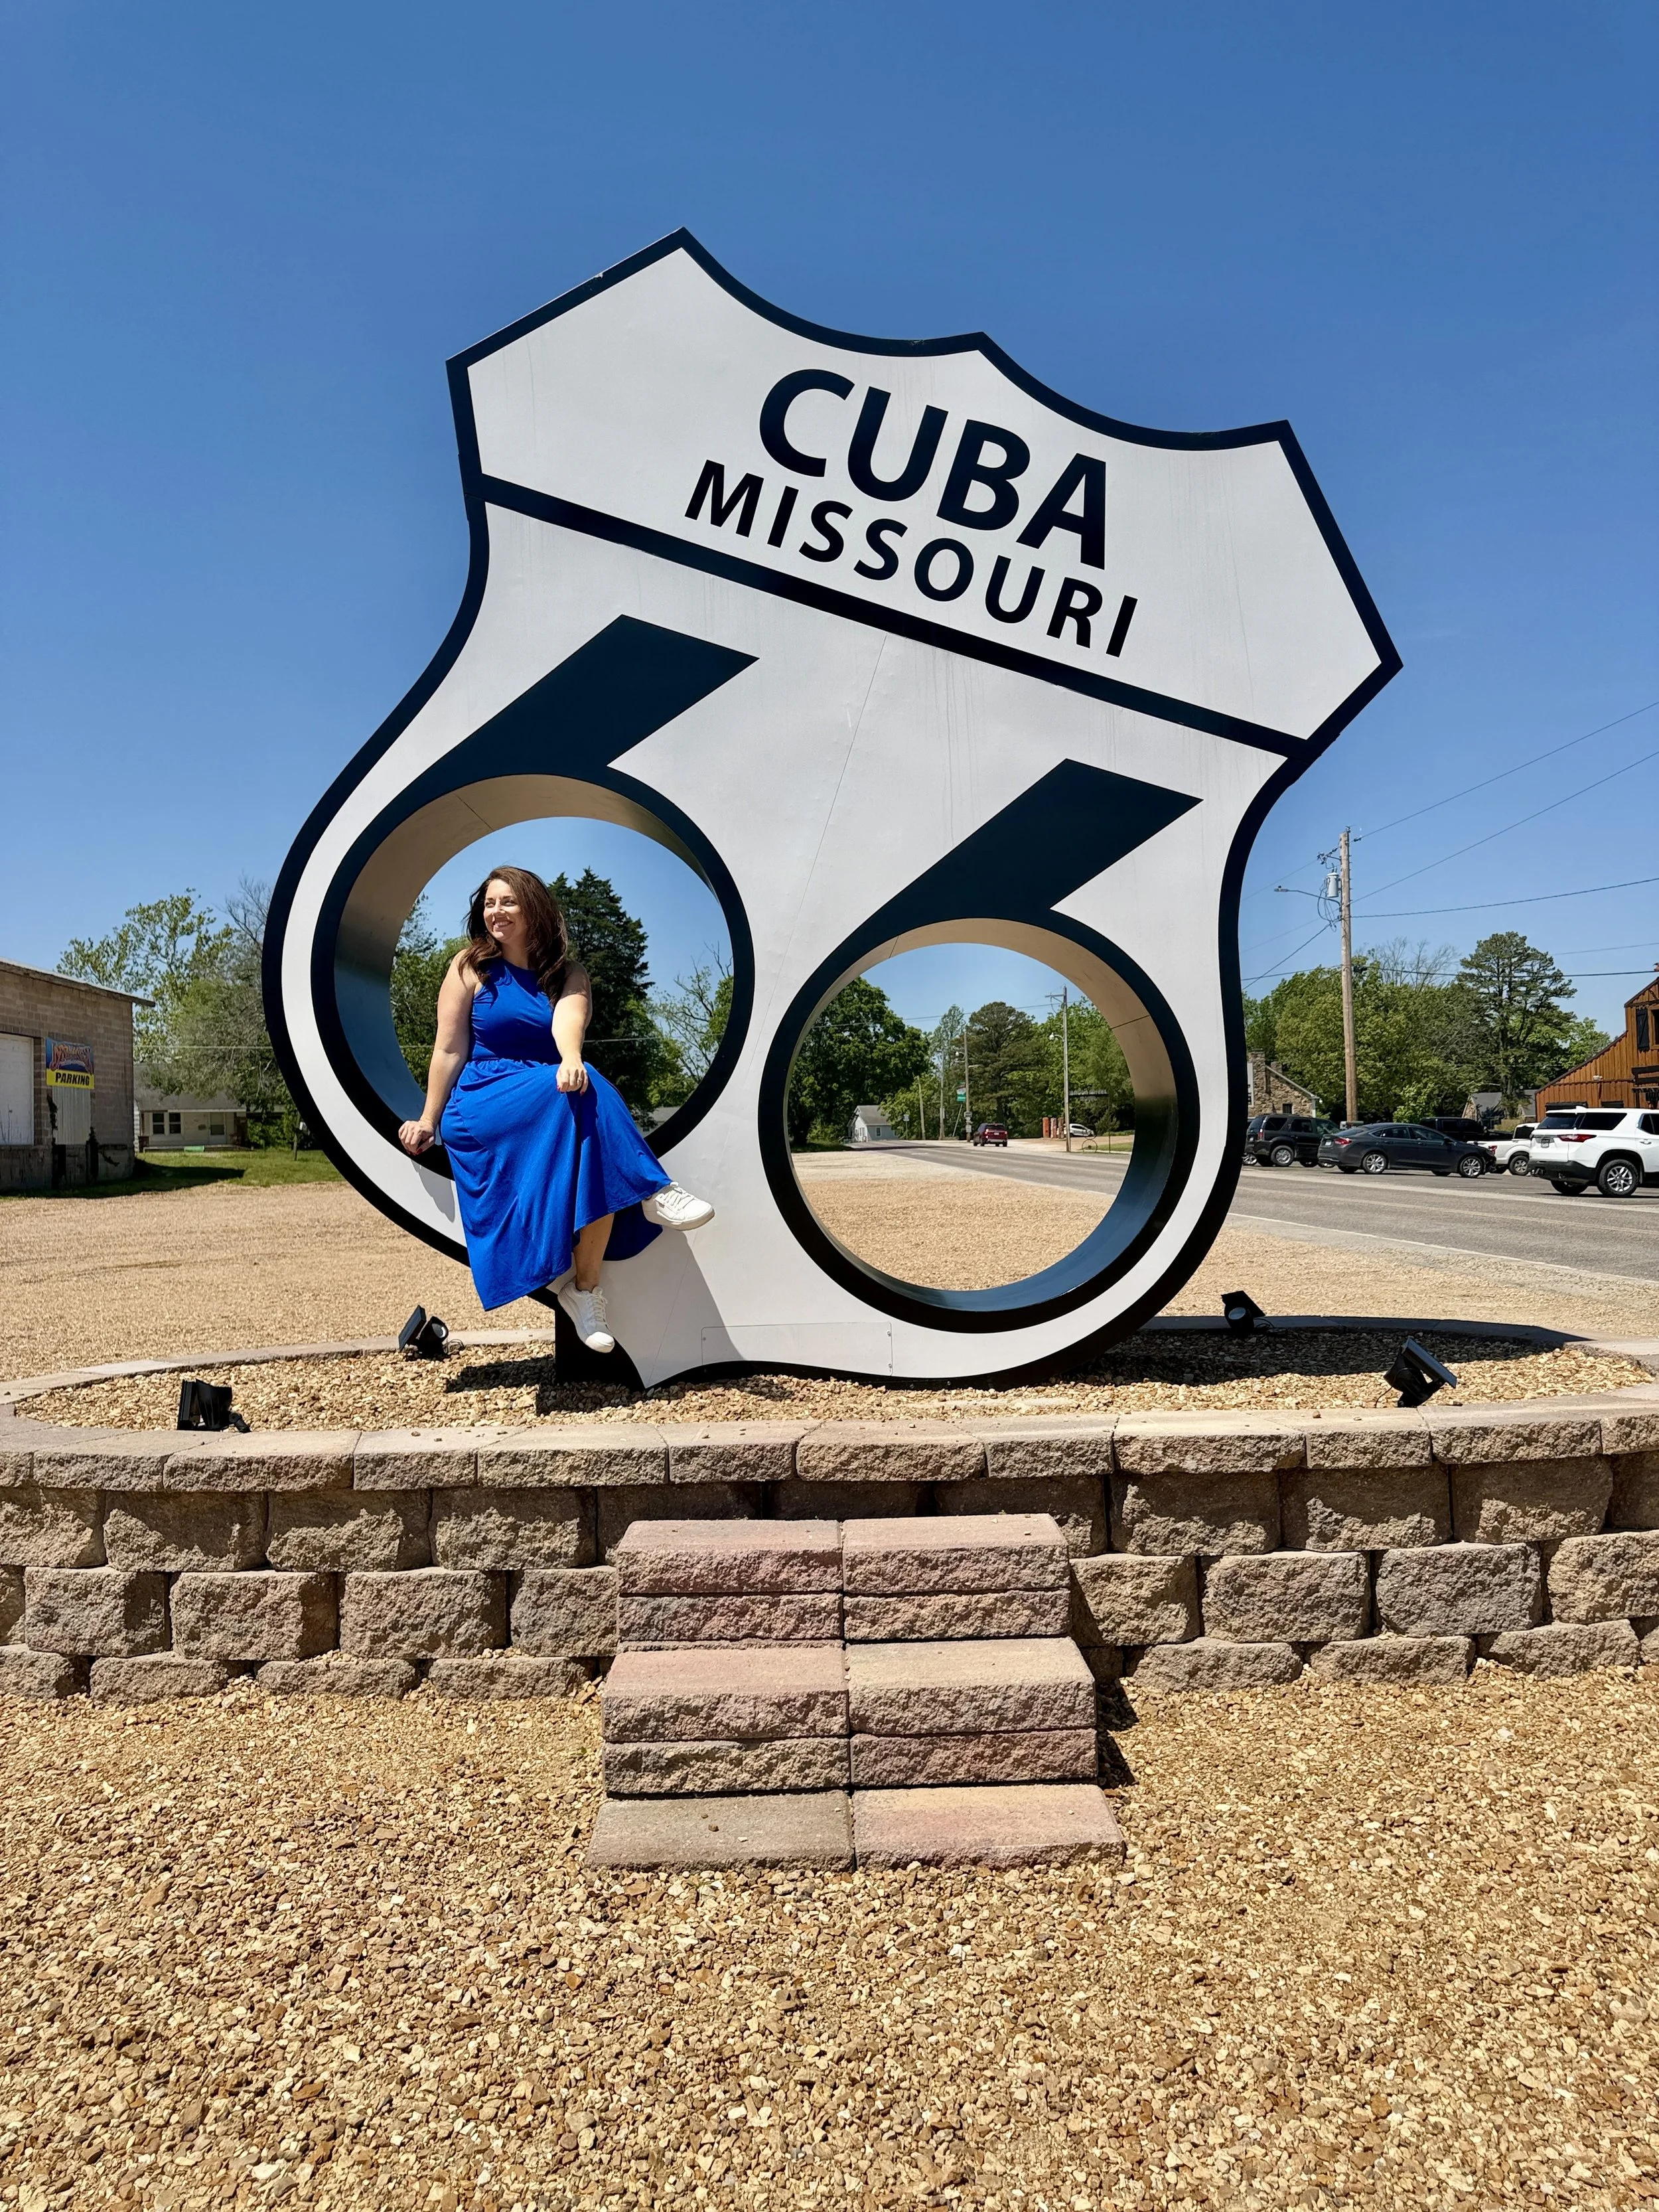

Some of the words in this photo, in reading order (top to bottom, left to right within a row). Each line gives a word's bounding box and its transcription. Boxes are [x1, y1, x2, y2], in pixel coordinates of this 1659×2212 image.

[685, 459, 1138, 658] MISSOURI
[760, 369, 1106, 570] CUBA
[310, 615, 1203, 1333] 66
[55, 1072, 90, 1086] PARKING
